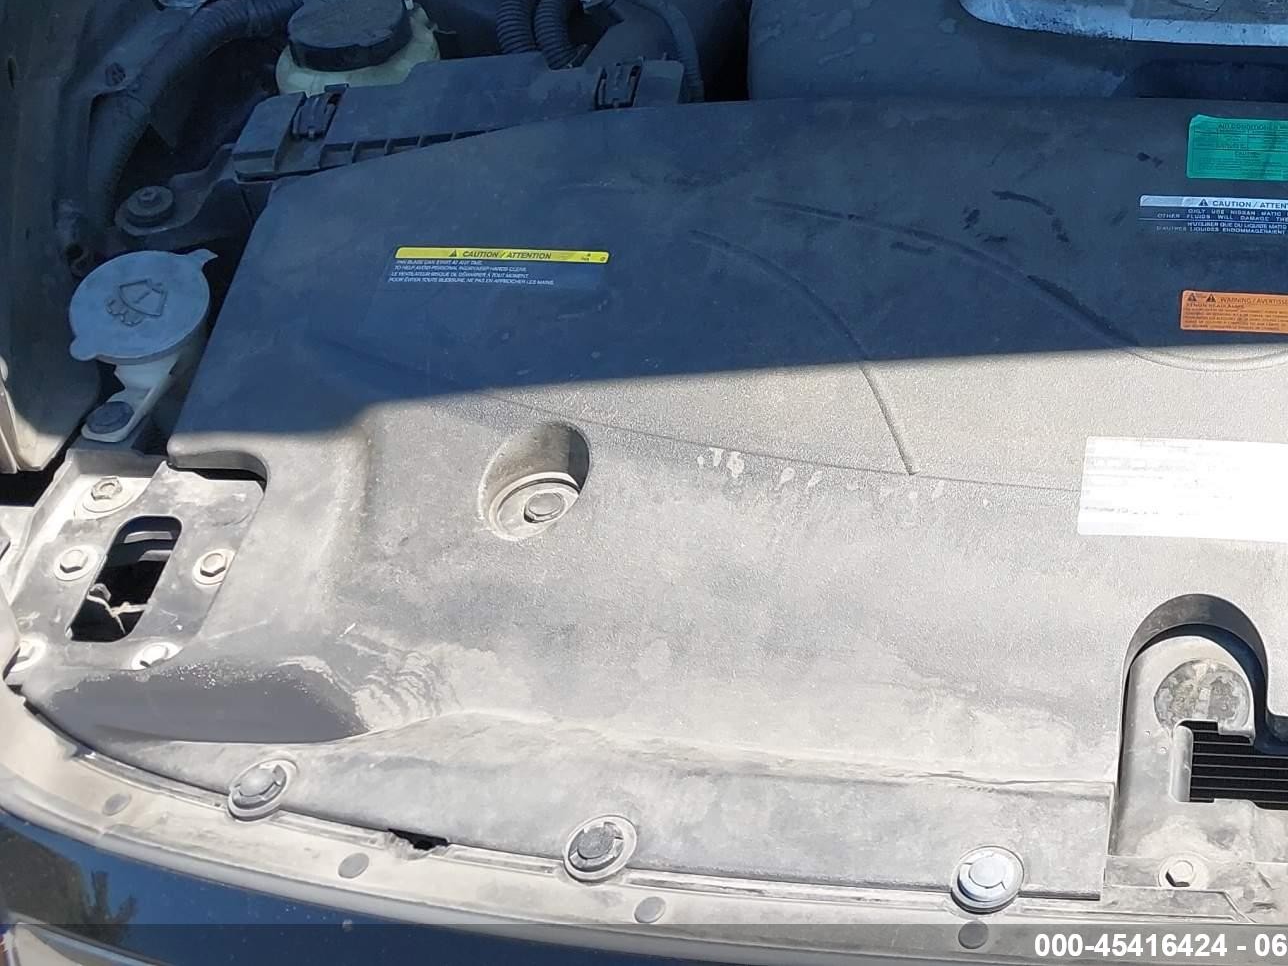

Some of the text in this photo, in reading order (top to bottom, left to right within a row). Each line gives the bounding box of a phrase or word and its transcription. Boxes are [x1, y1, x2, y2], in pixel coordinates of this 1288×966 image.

[1212, 200, 1251, 208] CAUTION
[462, 250, 499, 259] CAUTION
[506, 251, 552, 260] ATTENTION
[1220, 296, 1252, 304] WARNING
